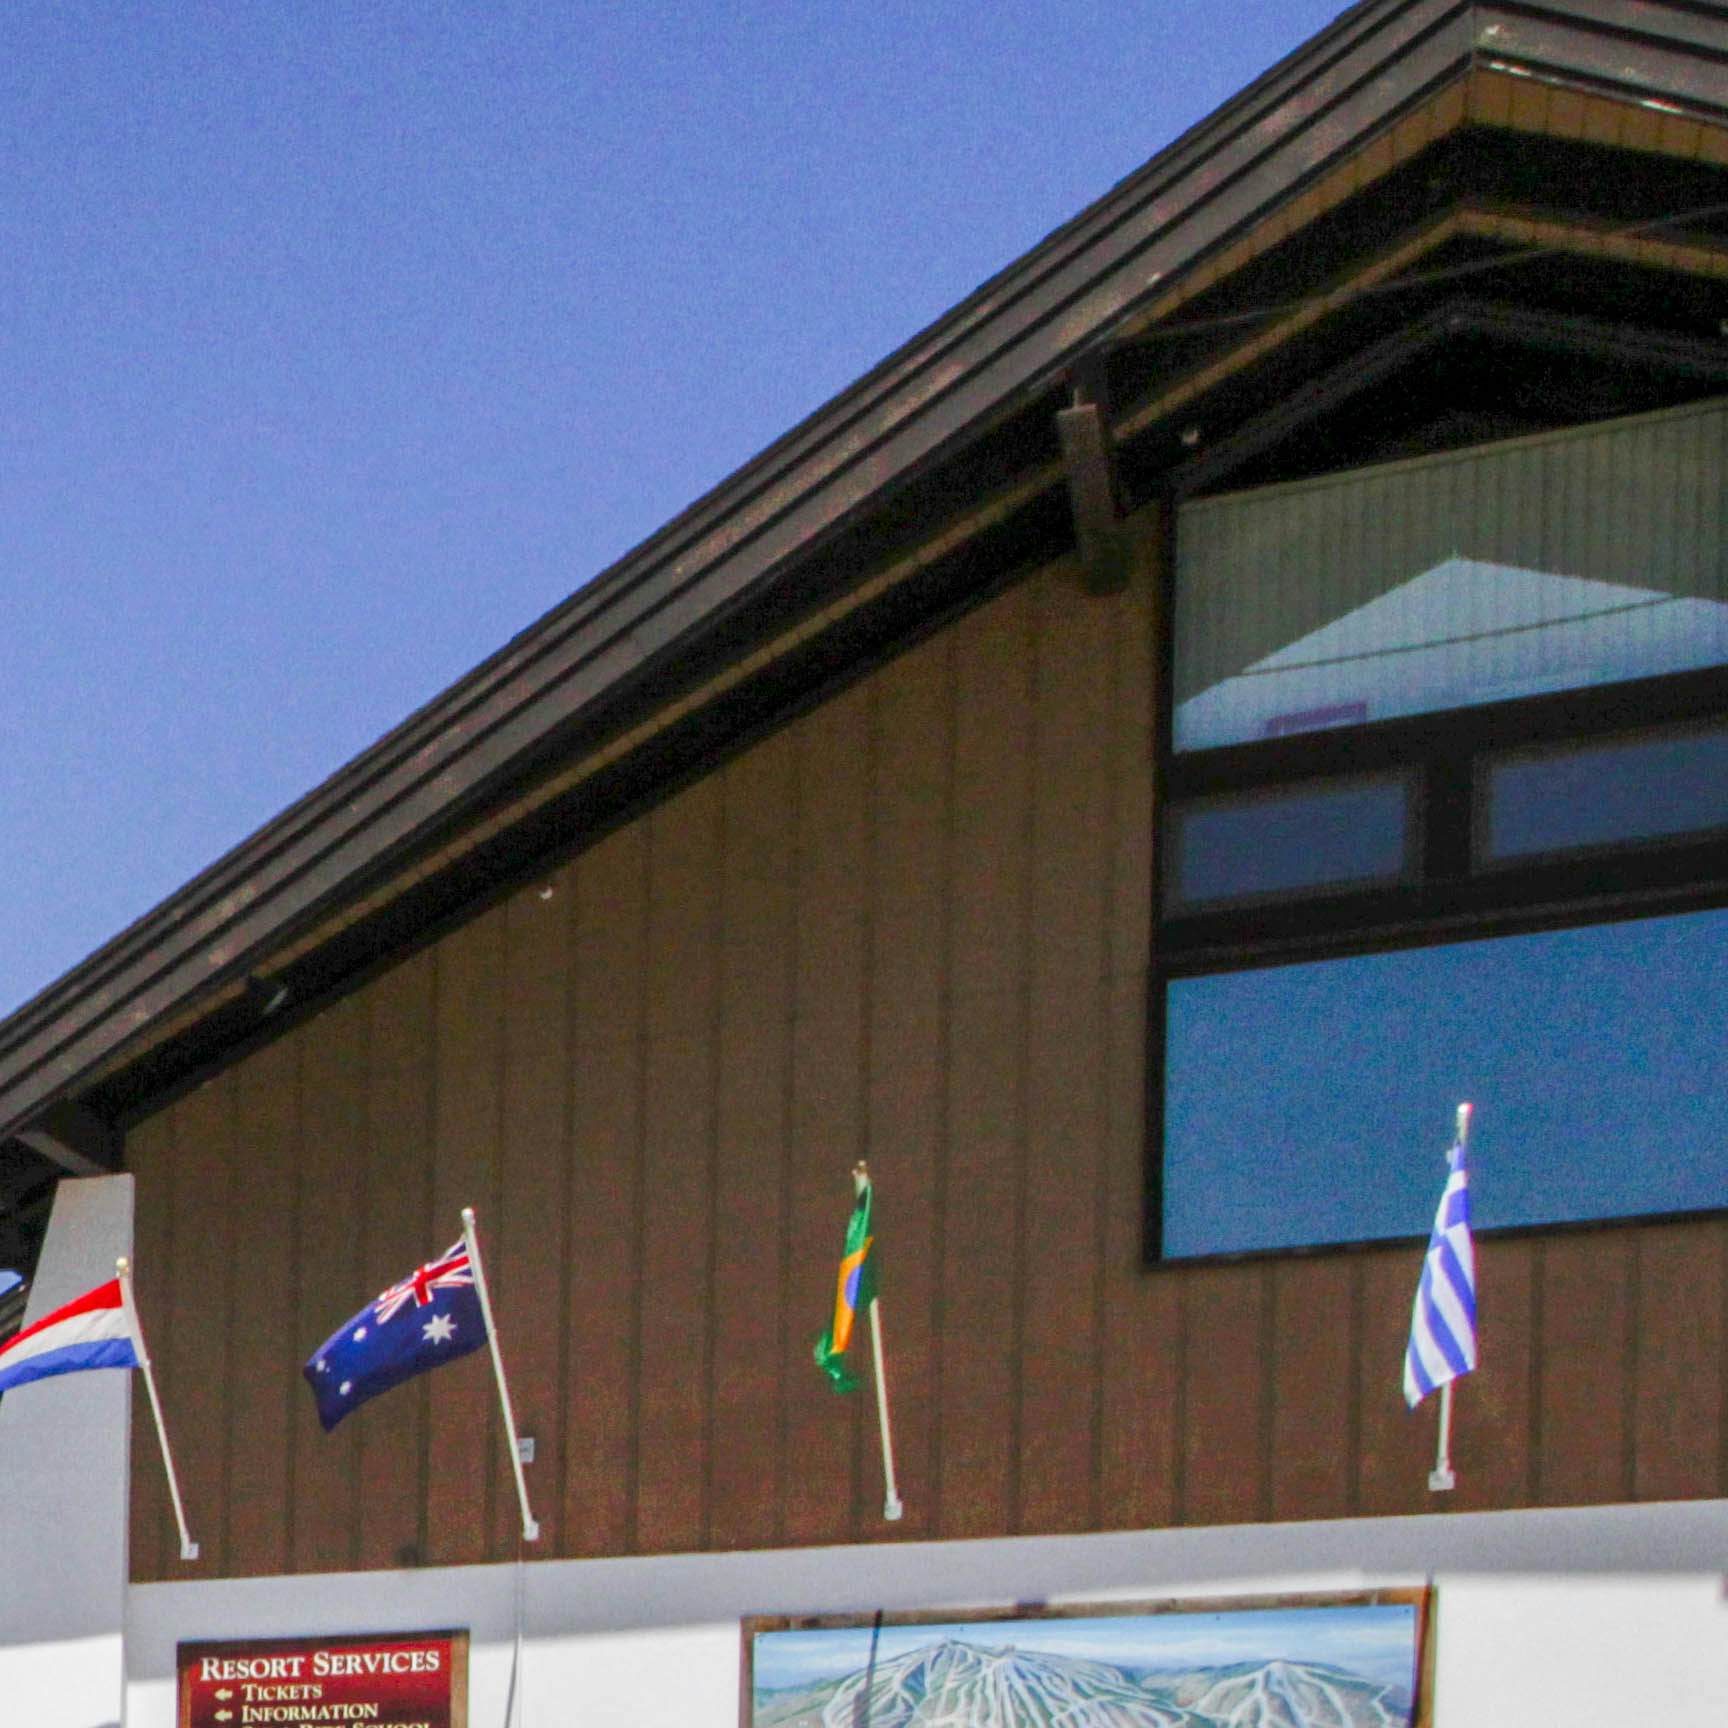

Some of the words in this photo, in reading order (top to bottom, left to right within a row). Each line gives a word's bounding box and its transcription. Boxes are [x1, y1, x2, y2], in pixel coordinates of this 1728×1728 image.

[200, 1657, 305, 1681] RESORT
[313, 1650, 440, 1676] SERVICES
[241, 1683, 323, 1701] TICKETS
[242, 1703, 379, 1723] INFORMATION
